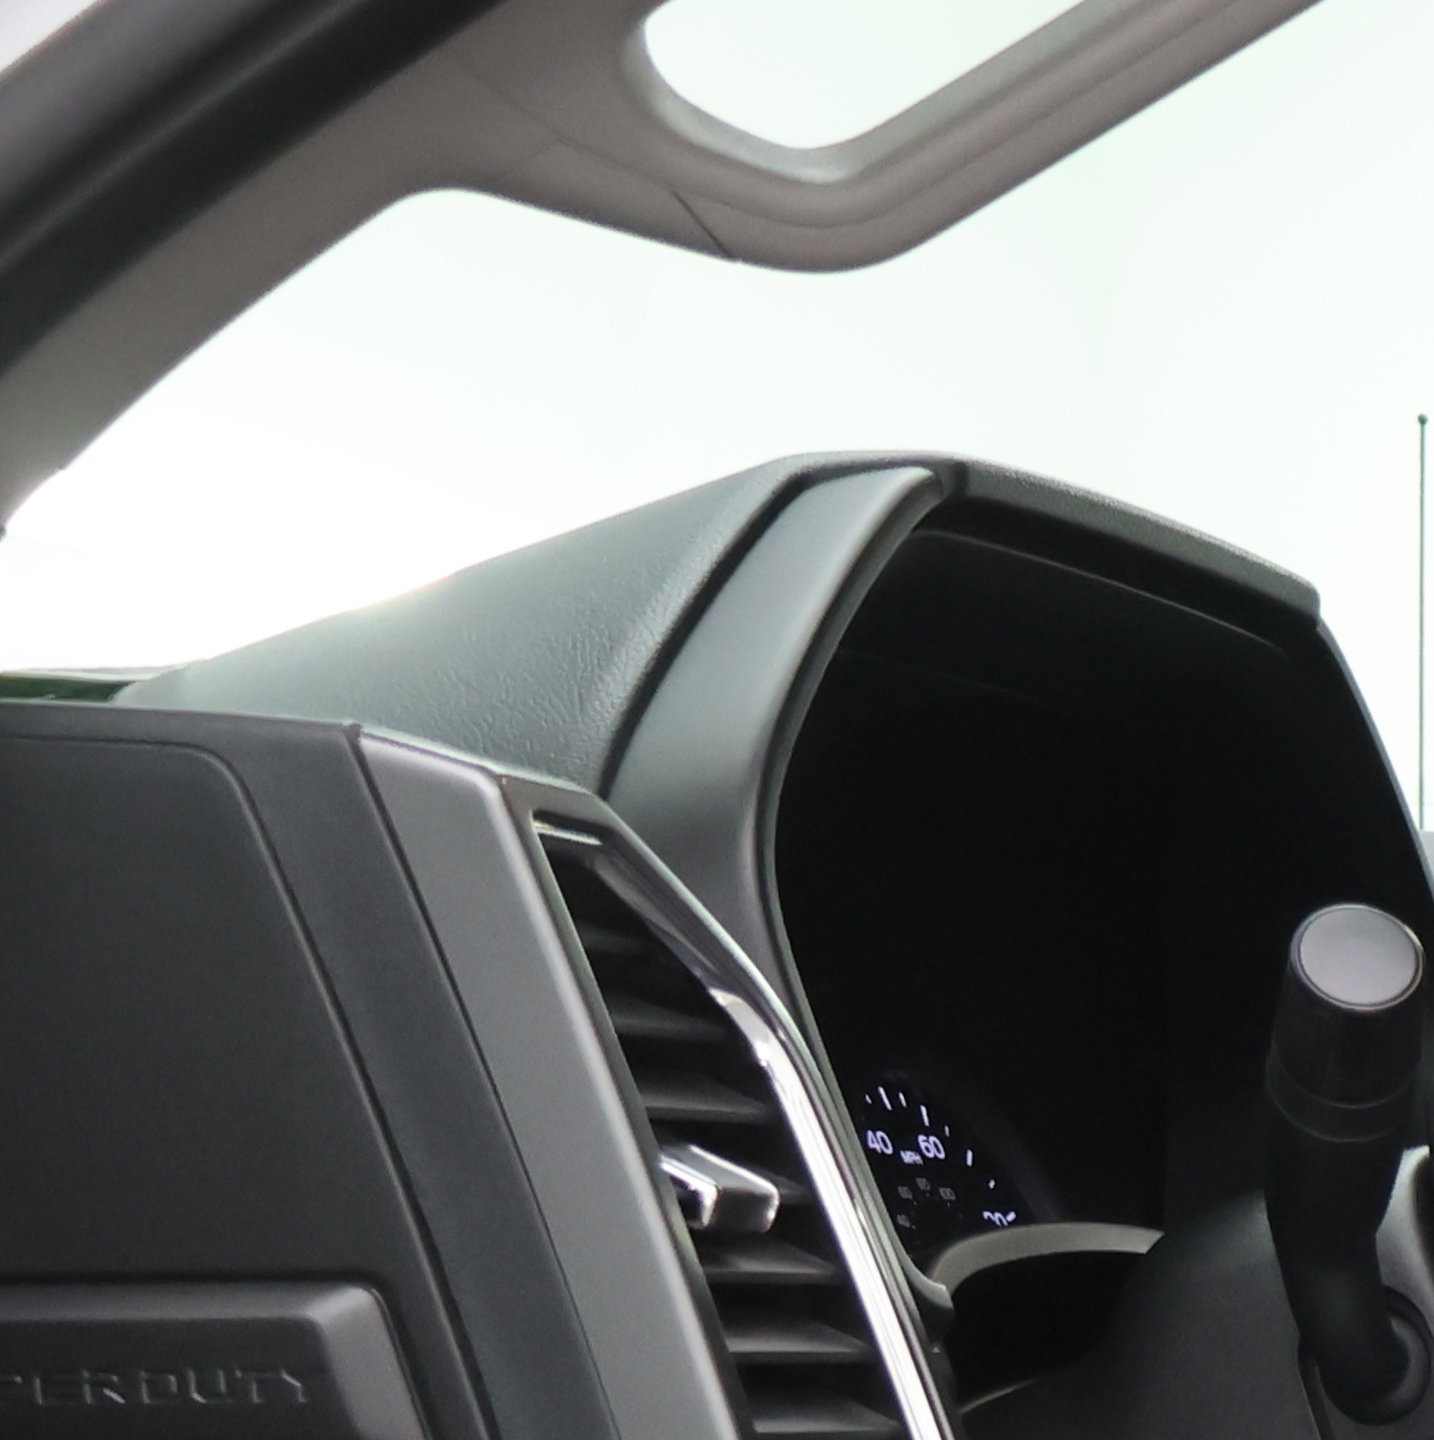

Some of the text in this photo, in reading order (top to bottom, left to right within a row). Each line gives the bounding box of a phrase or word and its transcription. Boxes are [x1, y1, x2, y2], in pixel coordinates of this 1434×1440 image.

[866, 1129, 894, 1155] 40
[917, 1134, 946, 1160] 60
[899, 1149, 924, 1166] MPH
